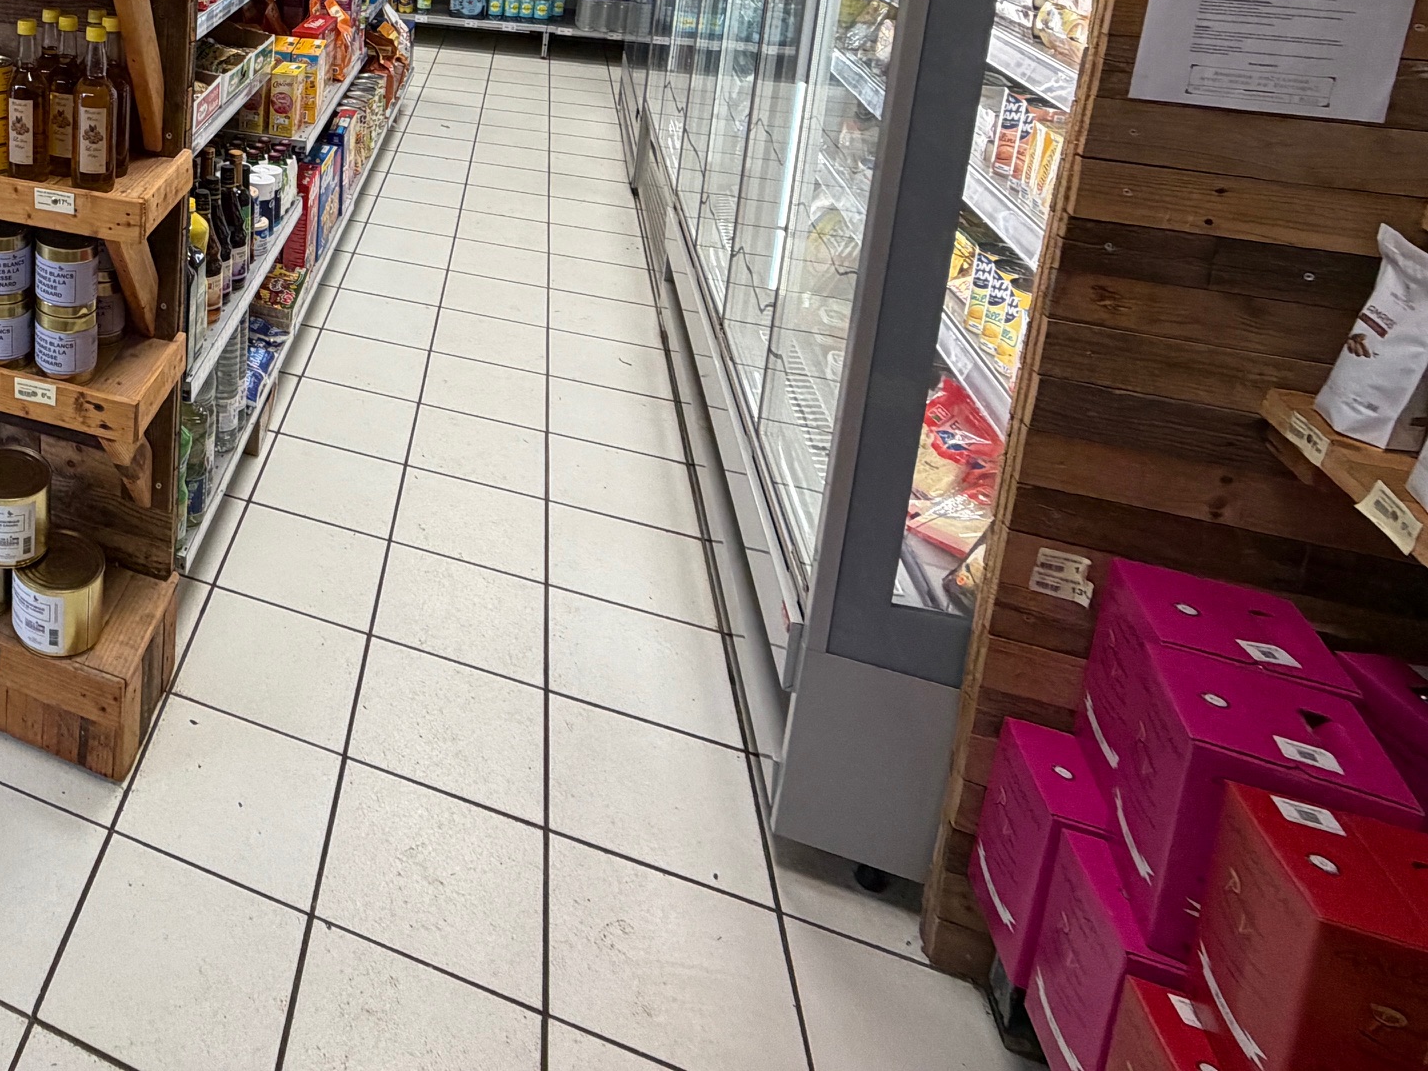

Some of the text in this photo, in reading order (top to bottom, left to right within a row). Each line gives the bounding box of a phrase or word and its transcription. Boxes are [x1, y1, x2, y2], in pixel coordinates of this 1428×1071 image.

[3, 259, 25, 268] BLANCS
[48, 271, 74, 280] BLANCS
[48, 341, 74, 349] BLANCS
